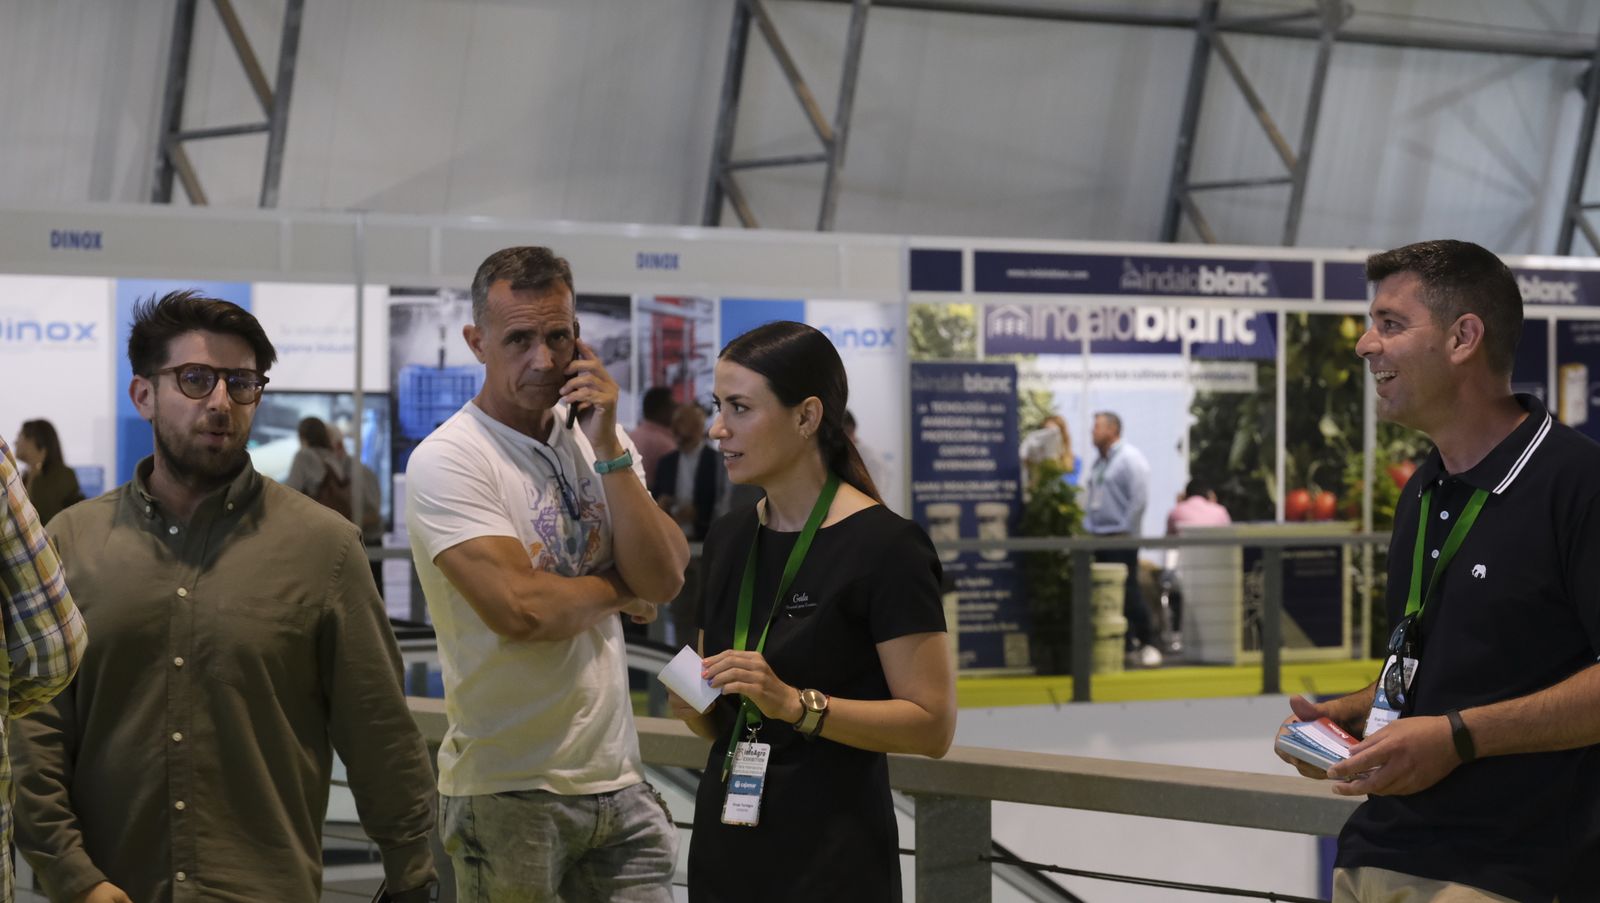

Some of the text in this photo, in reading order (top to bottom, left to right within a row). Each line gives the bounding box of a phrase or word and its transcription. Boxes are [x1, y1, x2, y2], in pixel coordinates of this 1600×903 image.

[50, 229, 103, 250] DINOX
[636, 251, 680, 270] DINOX
[1517, 274, 1578, 304] blanc
[0, 316, 97, 342] inox
